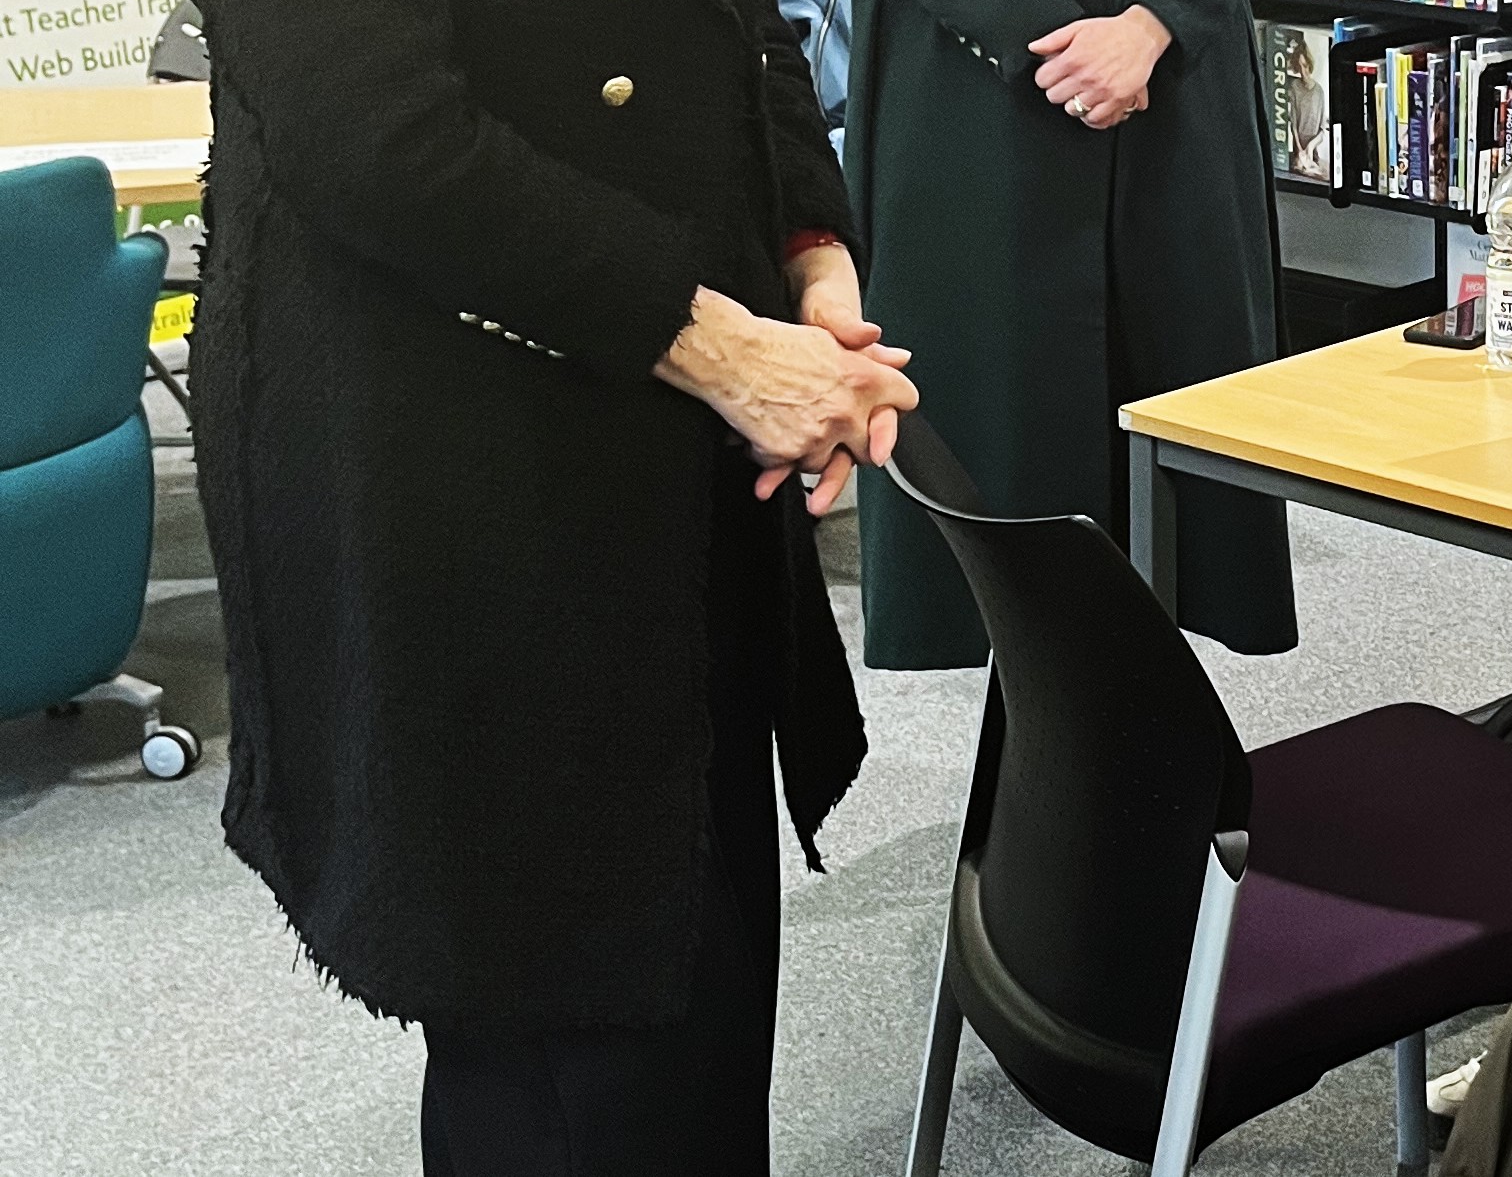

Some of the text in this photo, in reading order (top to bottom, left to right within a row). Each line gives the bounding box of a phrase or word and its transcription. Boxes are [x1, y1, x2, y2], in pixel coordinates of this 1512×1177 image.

[22, 0, 126, 34] Teacher
[9, 53, 73, 82] Web
[1274, 52, 1286, 142] CRUMB
[1410, 118, 1421, 142] ALAN
